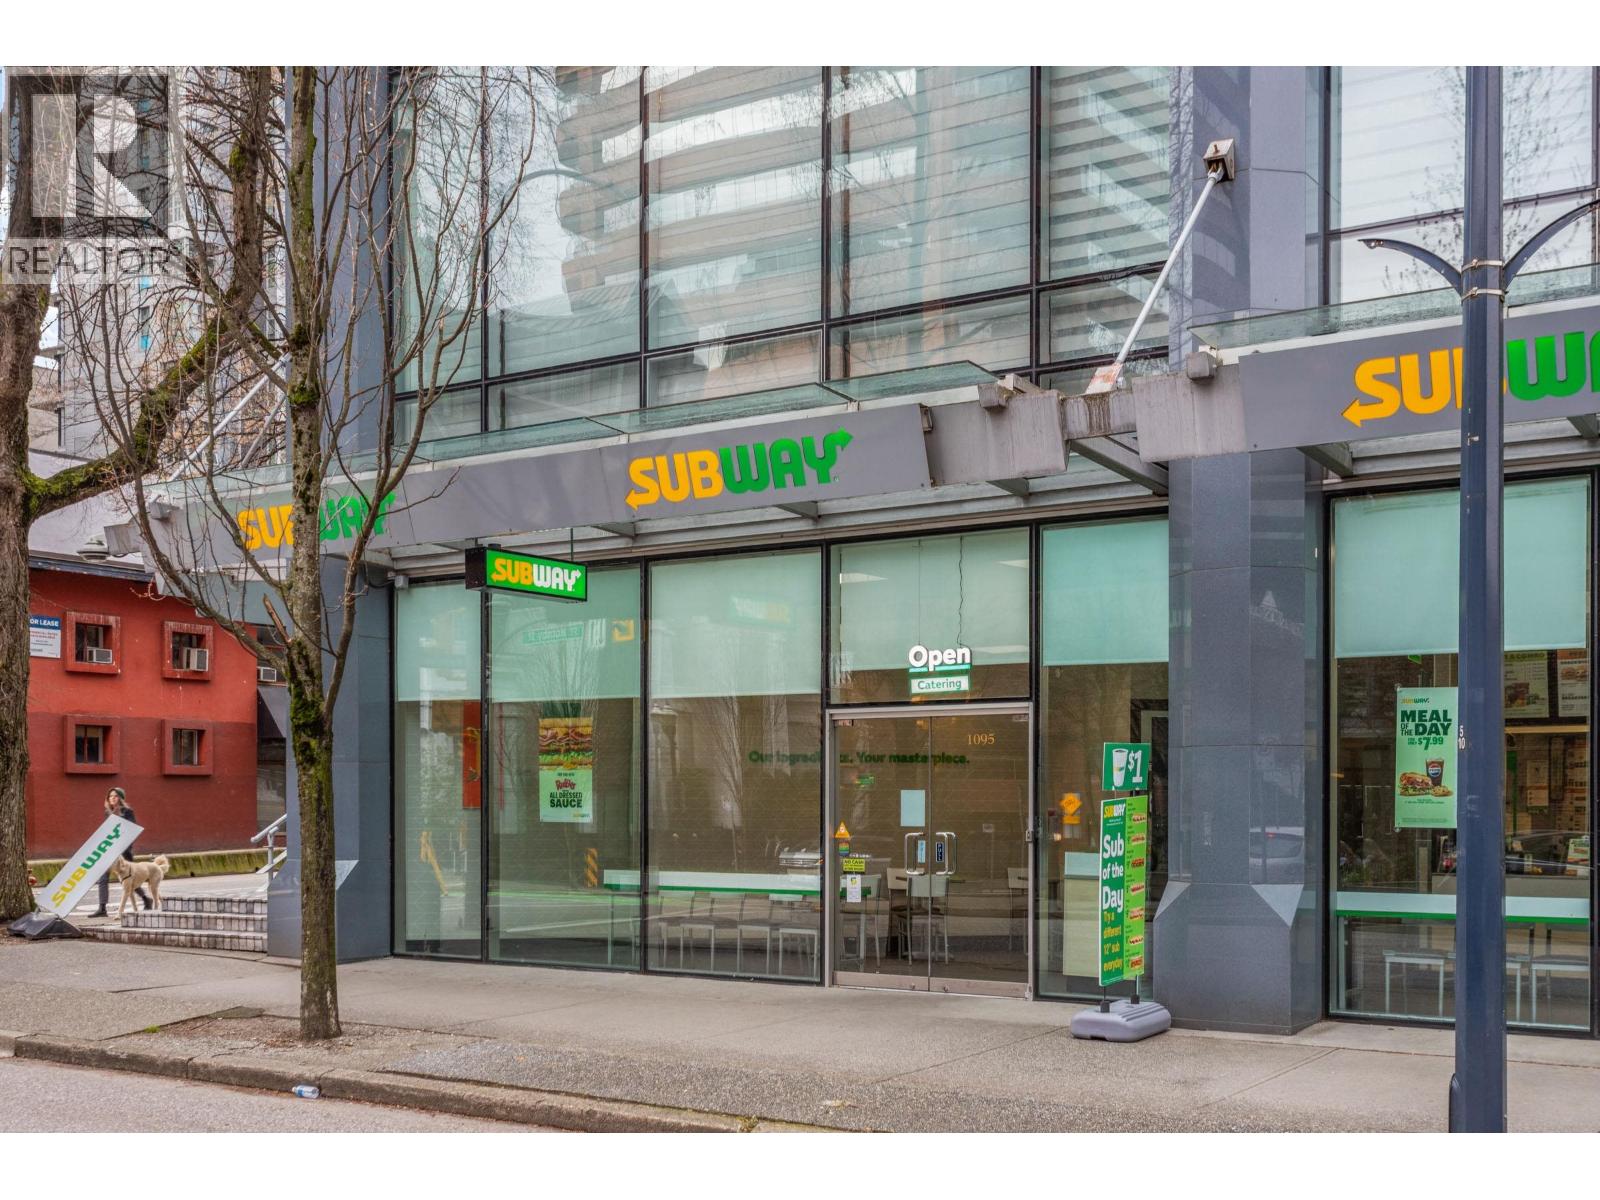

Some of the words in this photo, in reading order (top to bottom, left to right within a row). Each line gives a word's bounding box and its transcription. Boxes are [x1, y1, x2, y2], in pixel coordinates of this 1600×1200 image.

[1341, 330, 1600, 427] SUW
[625, 428, 853, 511] SUBWAY
[491, 558, 582, 592] SUBWAY
[40, 619, 59, 627] LEASE
[908, 645, 971, 671] Open
[917, 679, 962, 690] Catering
[1400, 709, 1452, 722] MEAL
[1400, 722, 1409, 730] OF
[1414, 722, 1452, 736] DAY
[1459, 725, 1464, 737] 5
[968, 734, 995, 745] 1095
[1417, 736, 1444, 750] $7.99
[1458, 737, 1466, 750] 10
[856, 751, 884, 763] Your
[1127, 750, 1143, 783] $1
[550, 799, 583, 808] SAUCE
[1102, 832, 1125, 859] Sub
[51, 823, 121, 909] SUBWAY
[1102, 863, 1111, 880] of
[1111, 862, 1124, 879] the
[1102, 886, 1124, 913] Day
